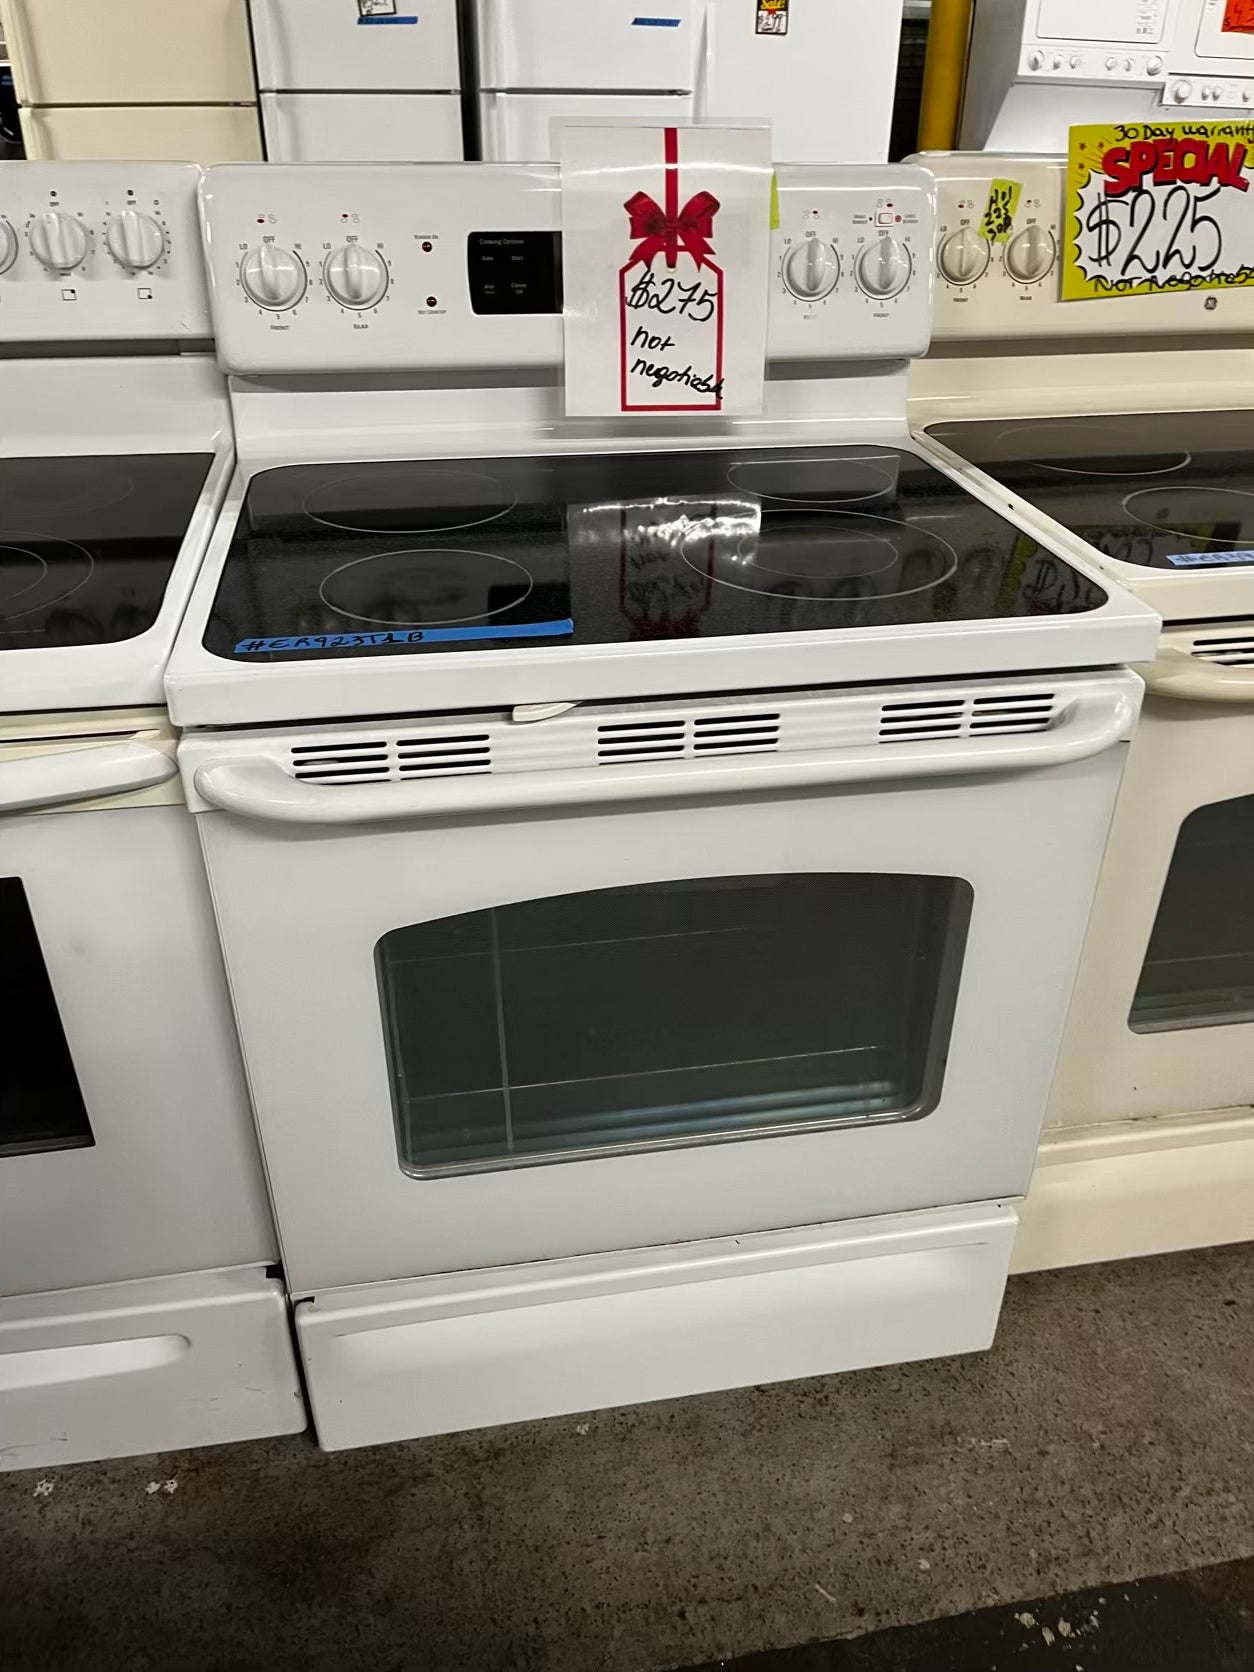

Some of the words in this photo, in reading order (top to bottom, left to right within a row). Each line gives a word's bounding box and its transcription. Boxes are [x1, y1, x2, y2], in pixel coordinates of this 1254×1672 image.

[1114, 125, 1139, 141] 30
[1143, 124, 1176, 144] Day
[1102, 138, 1249, 198] SPECIAL
[262, 235, 276, 243] OFF
[345, 235, 359, 243] OFF
[1086, 186, 1221, 276] $225
[626, 269, 717, 322] $275
[631, 326, 675, 351] not
